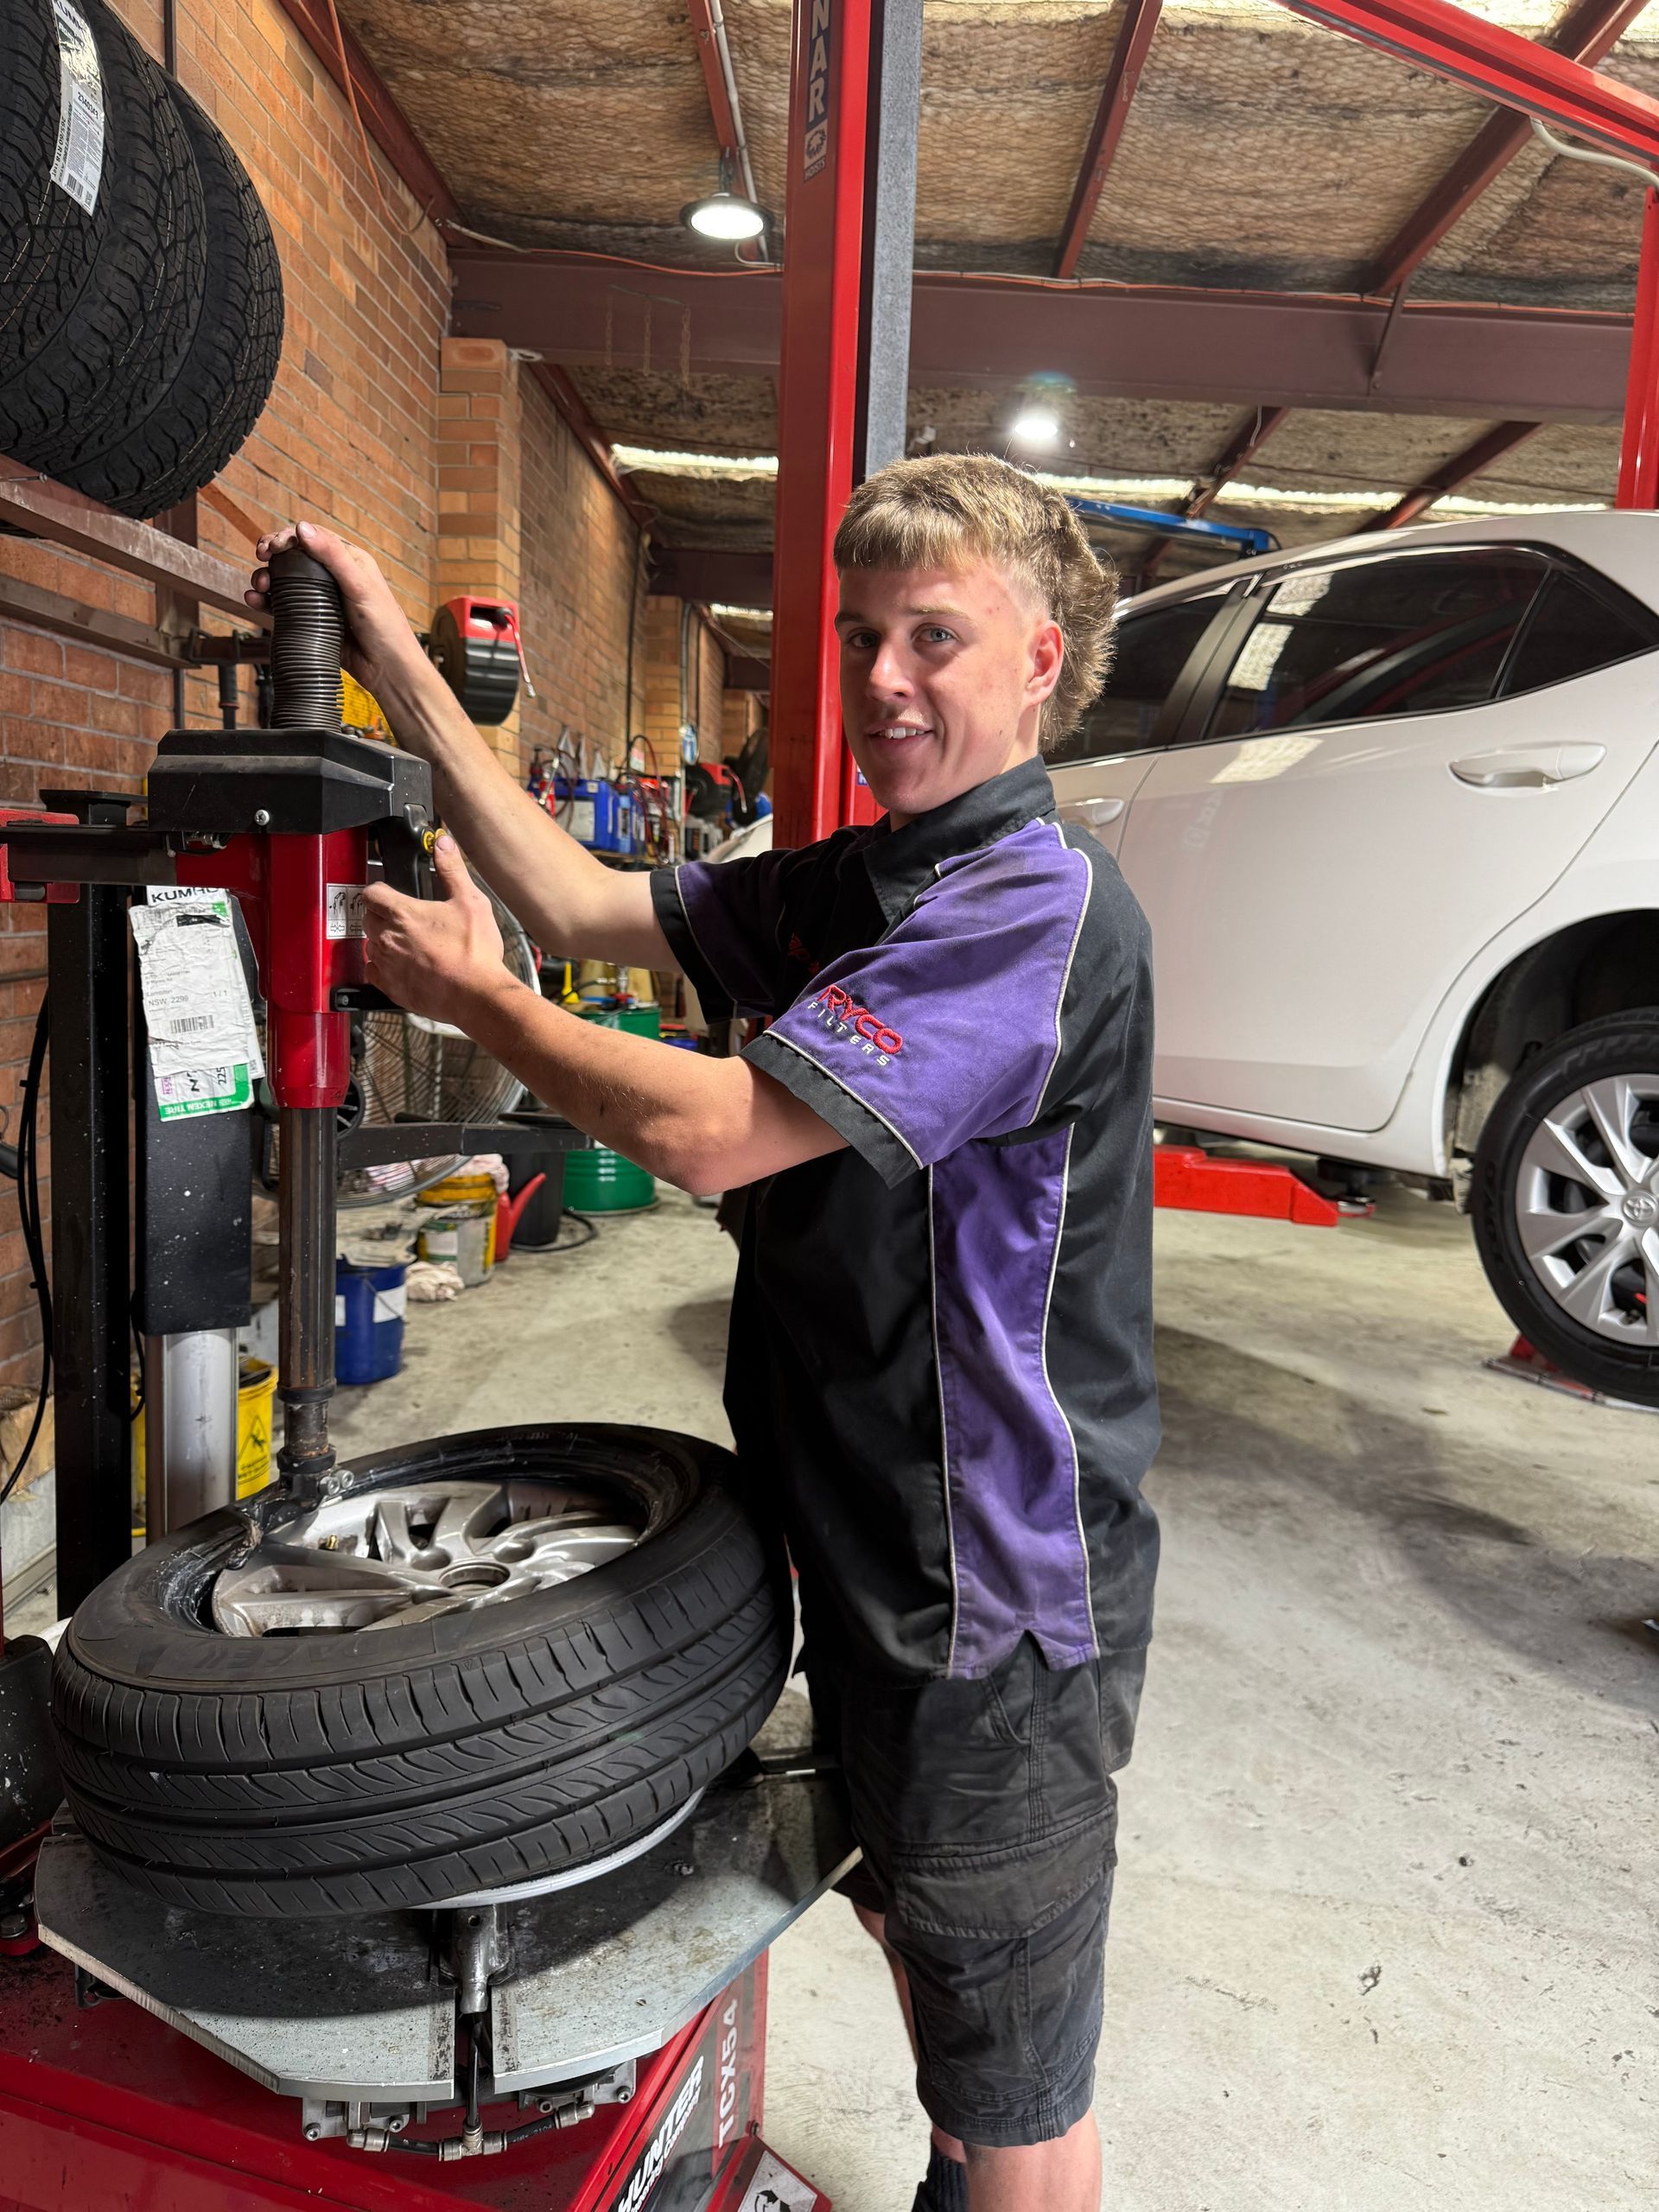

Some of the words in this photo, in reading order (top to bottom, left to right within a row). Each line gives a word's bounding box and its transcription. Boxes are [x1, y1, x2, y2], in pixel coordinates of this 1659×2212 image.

[807, 1001, 890, 1066] FILTERS
[817, 984, 902, 1054] RYCO
[164, 1104, 186, 1116] TIRE
